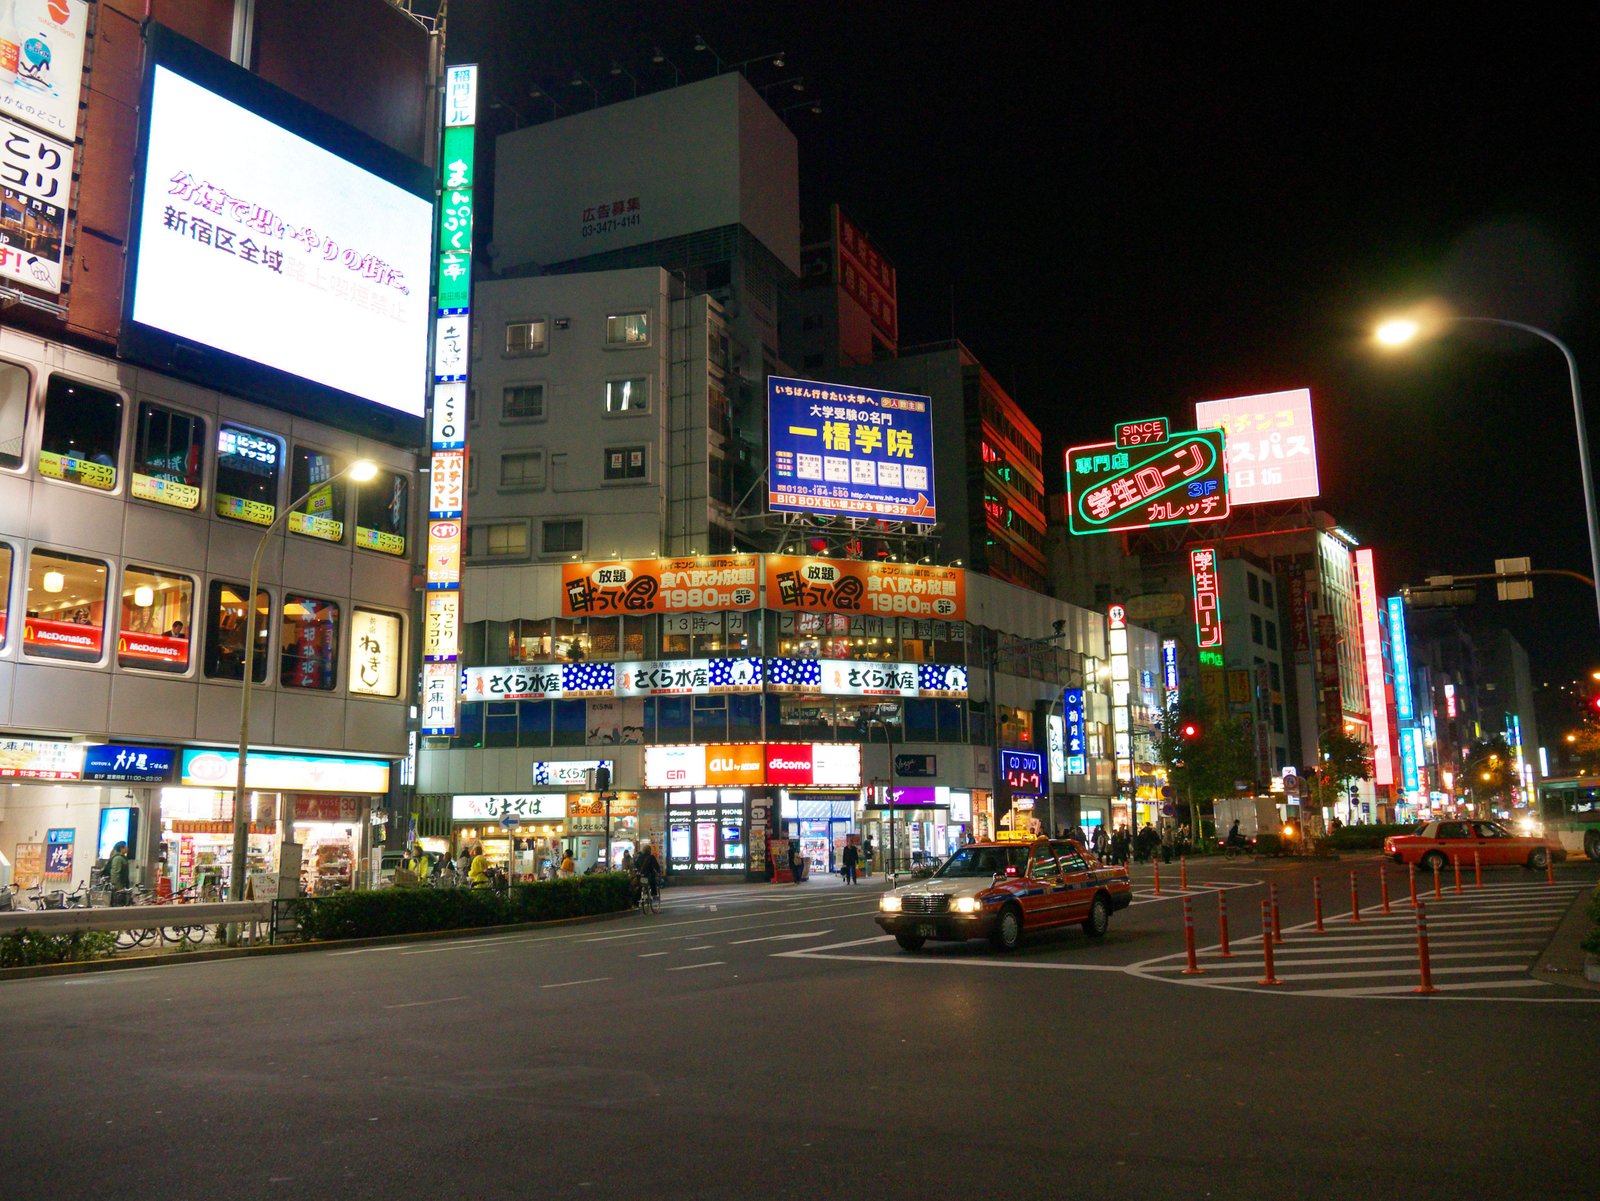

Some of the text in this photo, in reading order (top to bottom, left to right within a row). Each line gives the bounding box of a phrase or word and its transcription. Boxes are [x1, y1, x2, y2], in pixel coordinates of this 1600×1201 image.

[5, 131, 61, 170] こり
[164, 205, 283, 274] 新宿区全域
[776, 385, 879, 406] いちばん行きたい大学へ。
[810, 405, 892, 425] 大学受験の名門
[1122, 421, 1161, 436] SINCE
[789, 421, 913, 458] 一橋学院
[1121, 432, 1163, 446] 1977
[1231, 432, 1311, 463] スパス
[79, 462, 113, 475] にっこり
[1075, 453, 1129, 474] 専門店
[80, 471, 113, 484] マッコリ
[434, 459, 445, 508] スロット
[448, 458, 461, 507] パチンコ
[1087, 444, 1204, 519] 学生ローン
[166, 484, 197, 496] にっこり
[1188, 481, 1217, 497] 3F
[244, 501, 273, 513] にっこり
[777, 495, 796, 504] BIG
[432, 524, 458, 537] くすり
[599, 569, 626, 584] 放題
[660, 568, 755, 588] 食べ飲み放題
[808, 566, 835, 580] 放題
[867, 576, 956, 596] 食べ飲み放題
[660, 588, 730, 608] 1980円
[736, 595, 750, 604] 3F
[867, 593, 931, 614] 1980円
[1195, 552, 1218, 645] 学生ローン
[938, 605, 951, 613] 3F
[430, 613, 441, 647] マッコリ
[443, 604, 454, 639] にっこり
[37, 630, 91, 645] McDonald's
[130, 642, 178, 656] McDonald's
[490, 673, 560, 693] さくら水産
[635, 668, 708, 689] さくら水産
[848, 669, 914, 690] さくら水産
[428, 680, 445, 719] 石庫門
[0, 741, 34, 752] 庫門
[113, 749, 148, 771] 大戸屋
[709, 758, 733, 772] au
[769, 759, 811, 770] docomo
[1010, 757, 1020, 769] CD
[485, 796, 545, 816] 富士そば
